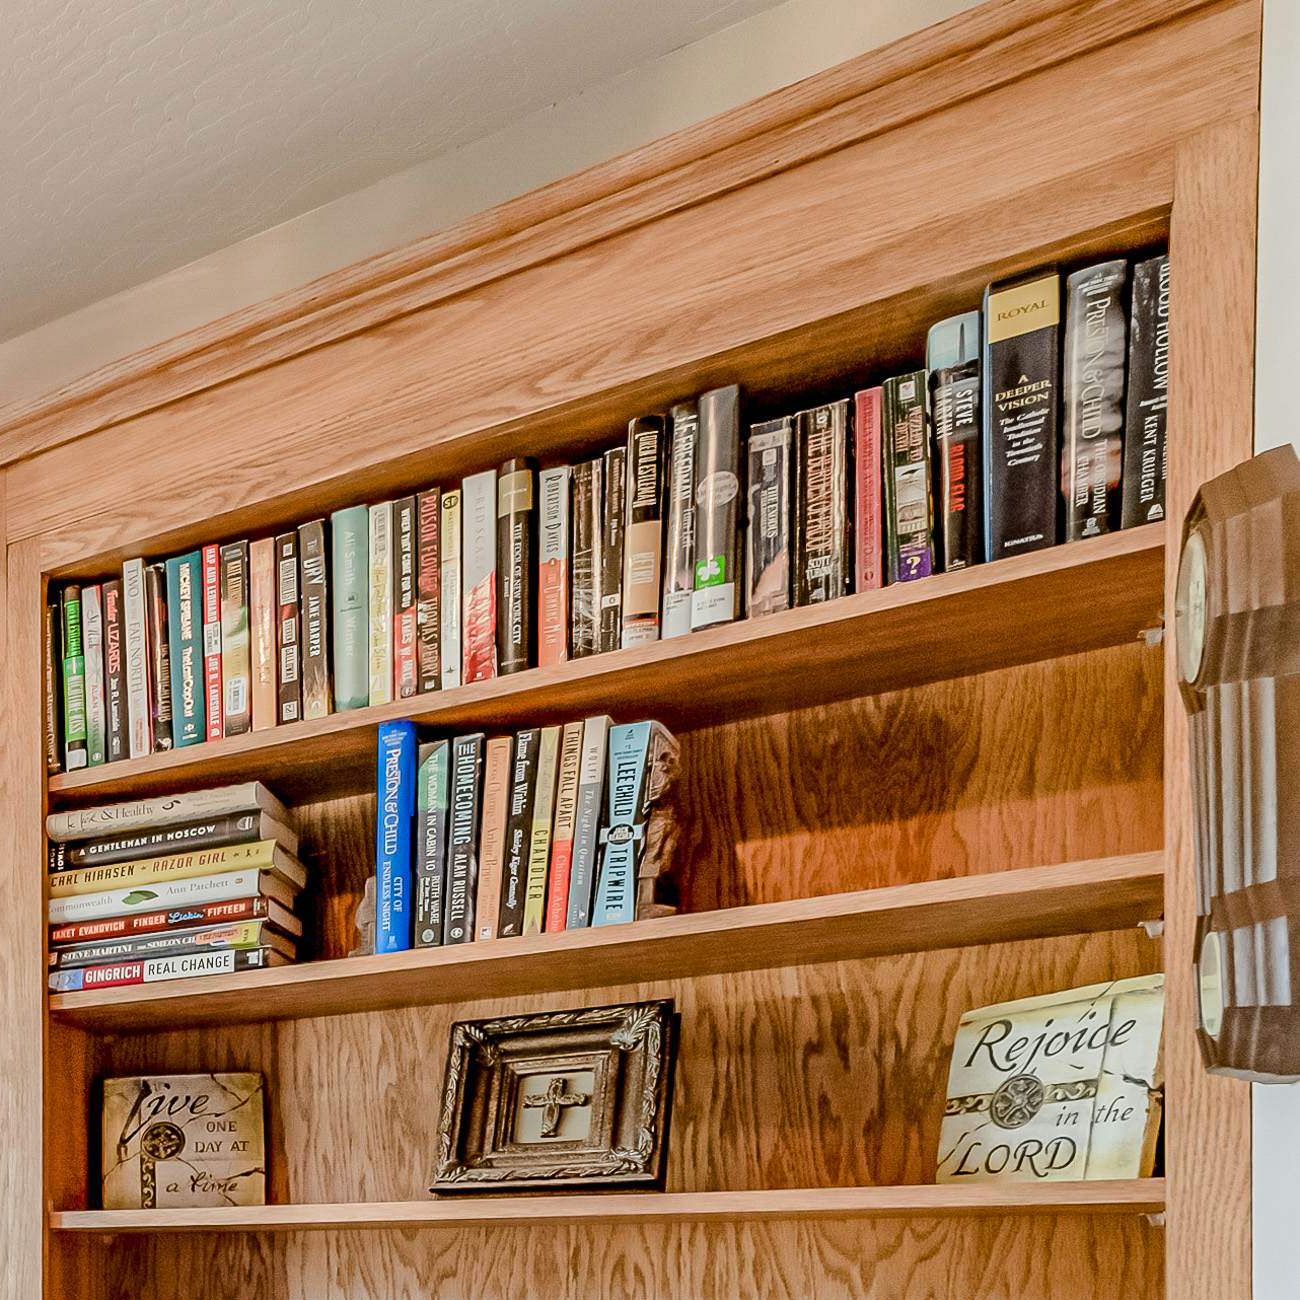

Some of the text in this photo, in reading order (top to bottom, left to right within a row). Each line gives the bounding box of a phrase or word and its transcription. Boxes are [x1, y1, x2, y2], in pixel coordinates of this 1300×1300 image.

[997, 299, 1050, 322] ROYAL
[1082, 296, 1111, 440] PRESTON CHILD
[956, 389, 973, 427] STEVE
[995, 379, 1052, 402] DEEPER
[998, 391, 1049, 412] VISION
[1140, 321, 1169, 504] HOLLOW KENT KRUEGER
[950, 484, 965, 513] FLAG
[1075, 455, 1089, 507] CHAMBER
[545, 475, 563, 553] ROBERTSON DAVIES
[179, 563, 191, 600] MICKEY
[421, 496, 438, 677] POISON FLOWER THOMAS PERRY
[126, 567, 142, 693] TWO FAR NORTH
[309, 596, 321, 657] JANE HARPER
[107, 623, 121, 674] LIZARDS
[209, 684, 219, 725] LANSDALE
[459, 743, 476, 756] THE
[428, 775, 439, 813] WOMAN
[558, 729, 580, 829] THINGS FALL APART
[384, 749, 401, 855] PRESTON CHILD
[510, 760, 530, 855] from Within Shirley
[89, 836, 148, 854] GENTLEMAN
[166, 824, 217, 841] MOSCOW
[427, 827, 437, 857] CABIN
[451, 756, 475, 922] HOMECOMING ALAN RUSSELL
[605, 760, 637, 911] LEE CHILD TRIPWIRE
[51, 852, 227, 888] CARL HIAASEN RAZOR GIRL
[426, 860, 436, 871] 10
[527, 829, 549, 901] CHANDLER
[574, 847, 588, 886] Question
[50, 879, 229, 913] ommonwealth Ann Patchett
[430, 899, 440, 925] WARE
[79, 921, 125, 936] EVANOVICH
[133, 915, 166, 928] FINGER
[207, 903, 246, 918] FIFTEEN
[85, 954, 230, 983] GINGRICH REAL CHANGE
[964, 1011, 1137, 1074] Rejoice
[120, 1079, 209, 1145] Live
[206, 1120, 237, 1132] ONE
[1056, 1096, 1134, 1127] in the
[194, 1141, 249, 1153] DAY AT
[951, 1136, 1076, 1177] LORD
[190, 1171, 238, 1193] time
